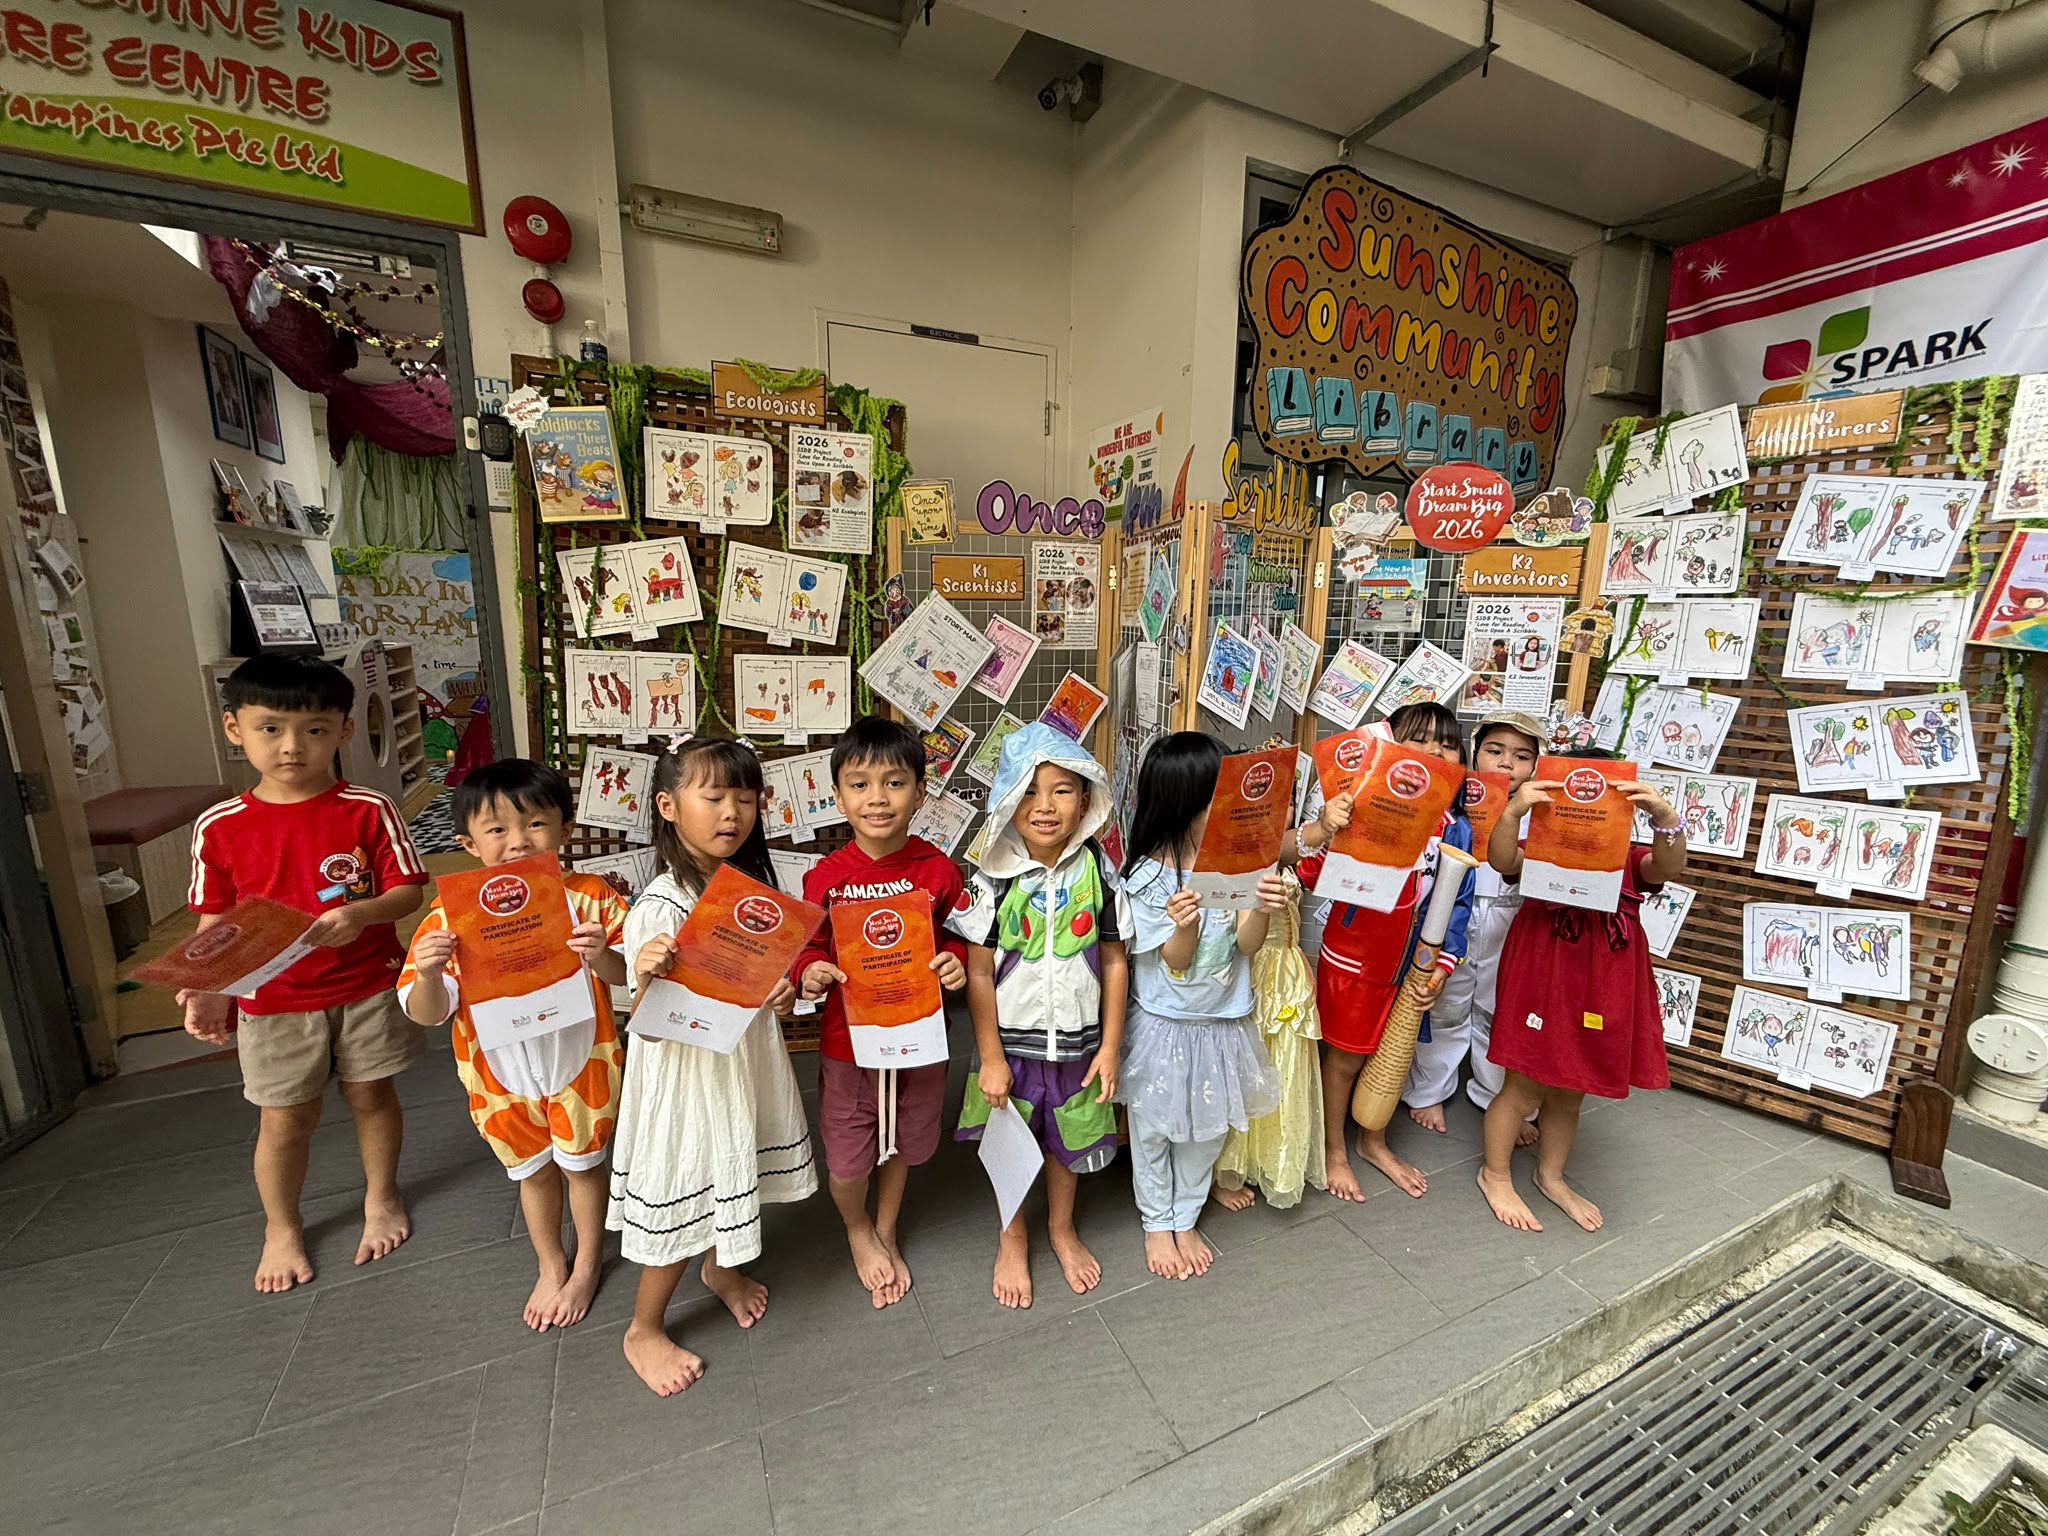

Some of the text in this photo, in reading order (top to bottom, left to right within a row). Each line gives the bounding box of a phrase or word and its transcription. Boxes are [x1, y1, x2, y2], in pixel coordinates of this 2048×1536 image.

[297, 7, 439, 80] KIDS
[0, 10, 325, 118] RE CENTRE
[0, 86, 343, 183] ampines Pte Ltd
[1317, 187, 1560, 345] Sunshine
[929, 329, 961, 340] ELECTRICAL
[1266, 255, 1560, 432] Community
[1830, 317, 1994, 384] SPARK
[725, 390, 817, 417] Ecologists
[1283, 370, 1533, 478] Library
[576, 432, 608, 444] Three
[797, 436, 828, 448] 2026
[577, 444, 611, 458] Bears
[1171, 444, 1195, 520] A
[1222, 438, 1317, 533] Scribble
[1417, 477, 1505, 499] Start Small
[912, 494, 938, 506] Once
[976, 479, 1106, 539] Once
[1417, 498, 1504, 519] Dream Big
[1432, 519, 1484, 540] 2026
[1038, 548, 1064, 558] 2026
[1511, 553, 1533, 570] K2
[972, 563, 988, 579] K1
[1246, 557, 1292, 584] Kindness
[1472, 569, 1569, 588] Inventors
[337, 576, 472, 605] A DAY IN
[941, 578, 1018, 594] Scientists
[1476, 604, 1511, 614] 2026
[943, 614, 964, 634] STORY
[962, 629, 977, 643] MAP
[1555, 805, 1597, 814] CERTIFICATE
[1555, 811, 1606, 821] PARTICIPATION
[828, 878, 914, 899] the AMAZING
[480, 913, 541, 933] CERTIFICATE OF
[483, 921, 543, 941] PARTICIPATION
[861, 952, 902, 963] CERTIFICATE
[863, 958, 913, 970] PARTICIPATION
